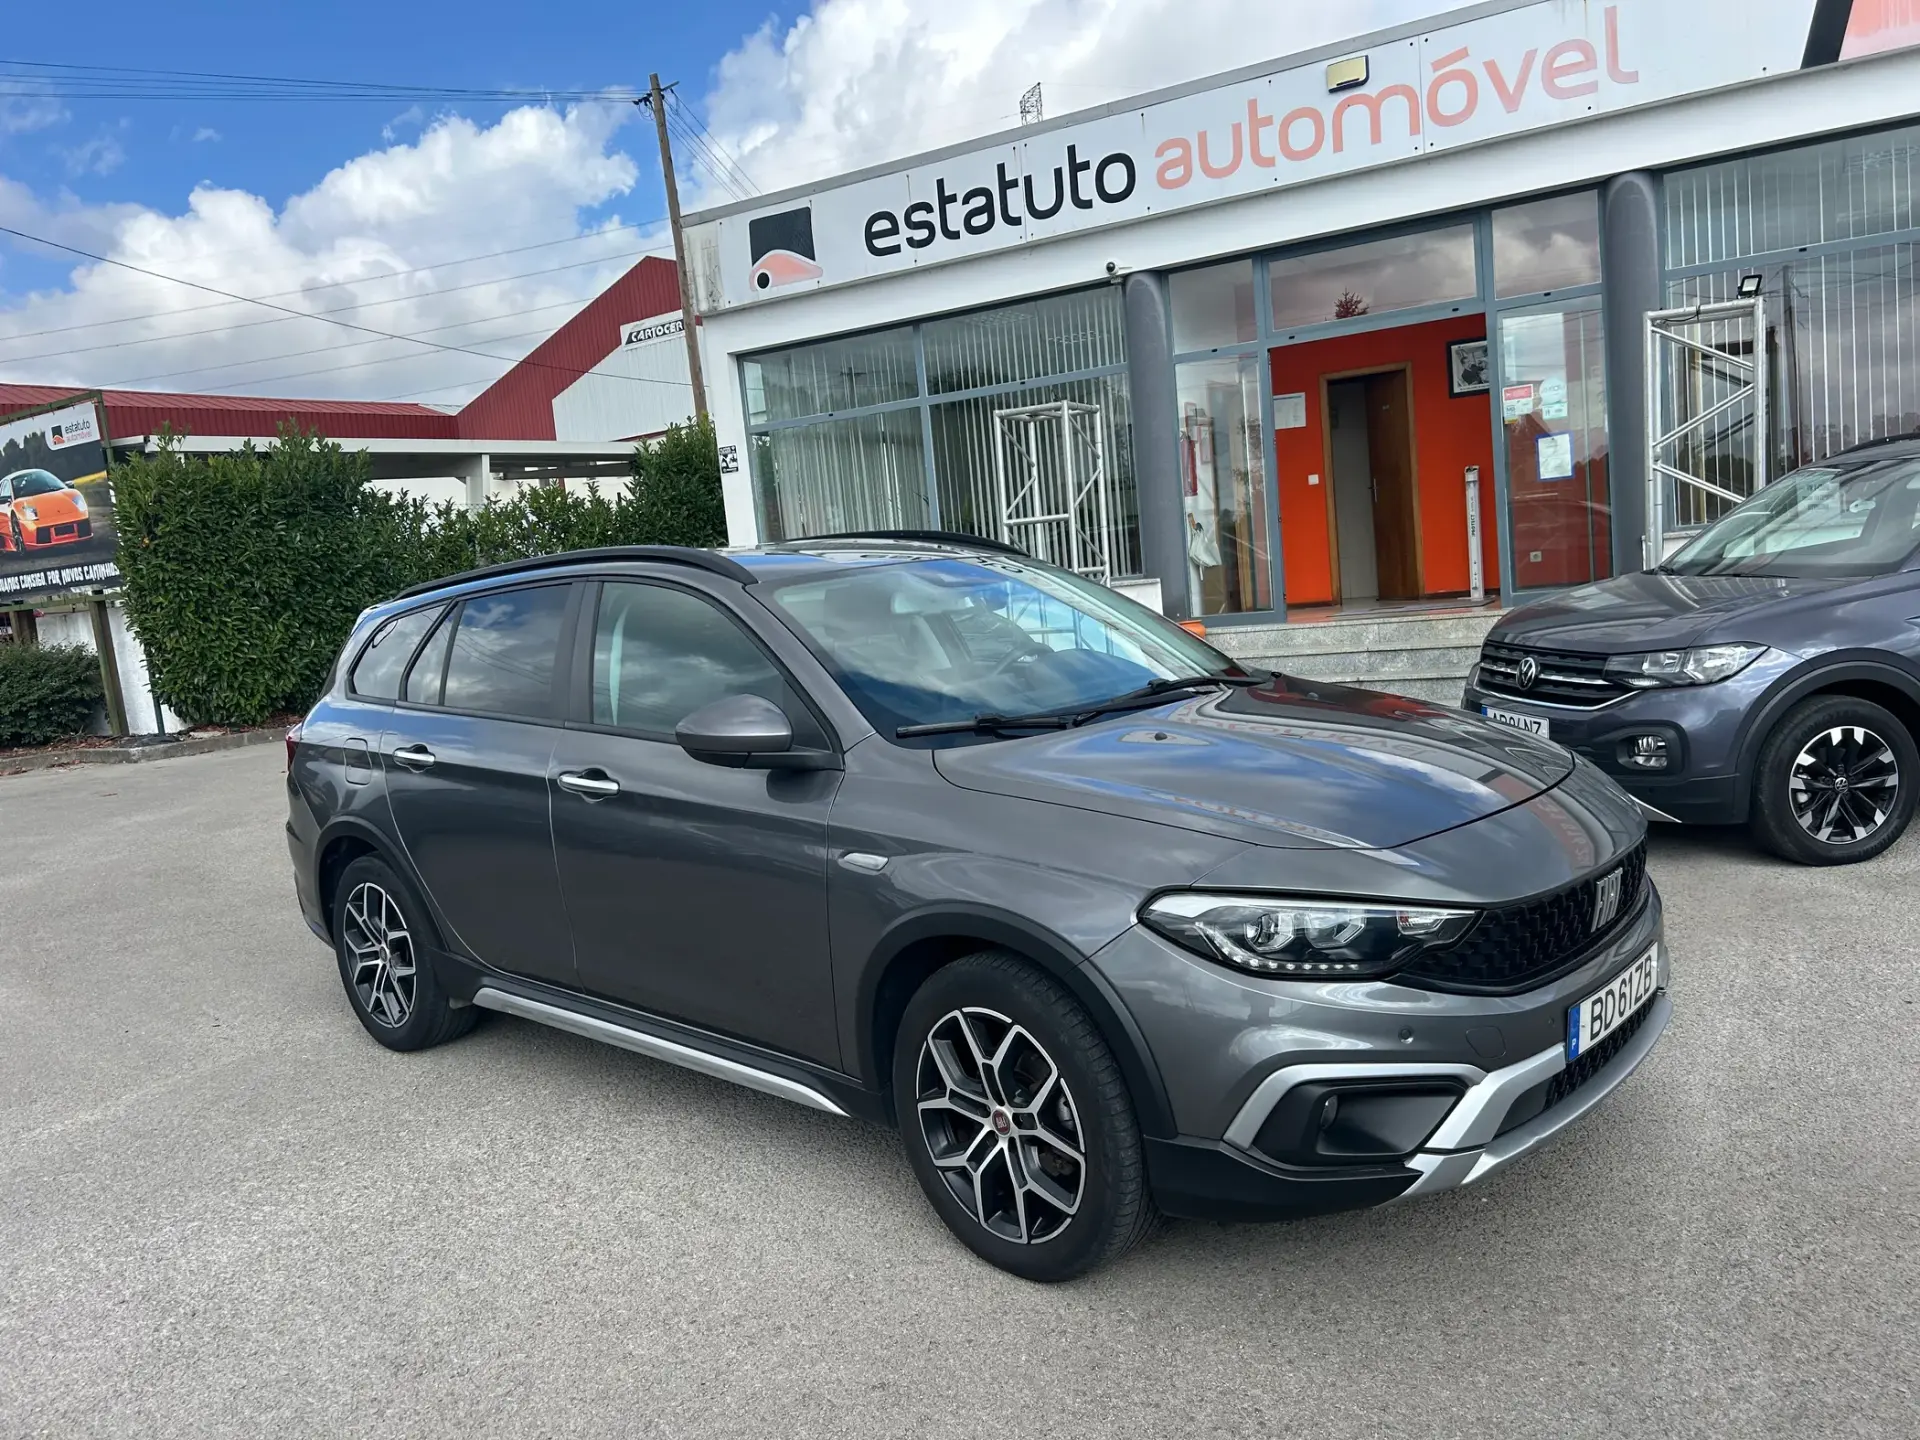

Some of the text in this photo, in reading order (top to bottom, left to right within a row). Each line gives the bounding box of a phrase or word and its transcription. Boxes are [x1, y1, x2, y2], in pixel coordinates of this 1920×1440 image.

[864, 5, 1639, 257] estatuto automóvel
[64, 418, 91, 434] estatuto
[46, 569, 62, 586] POR
